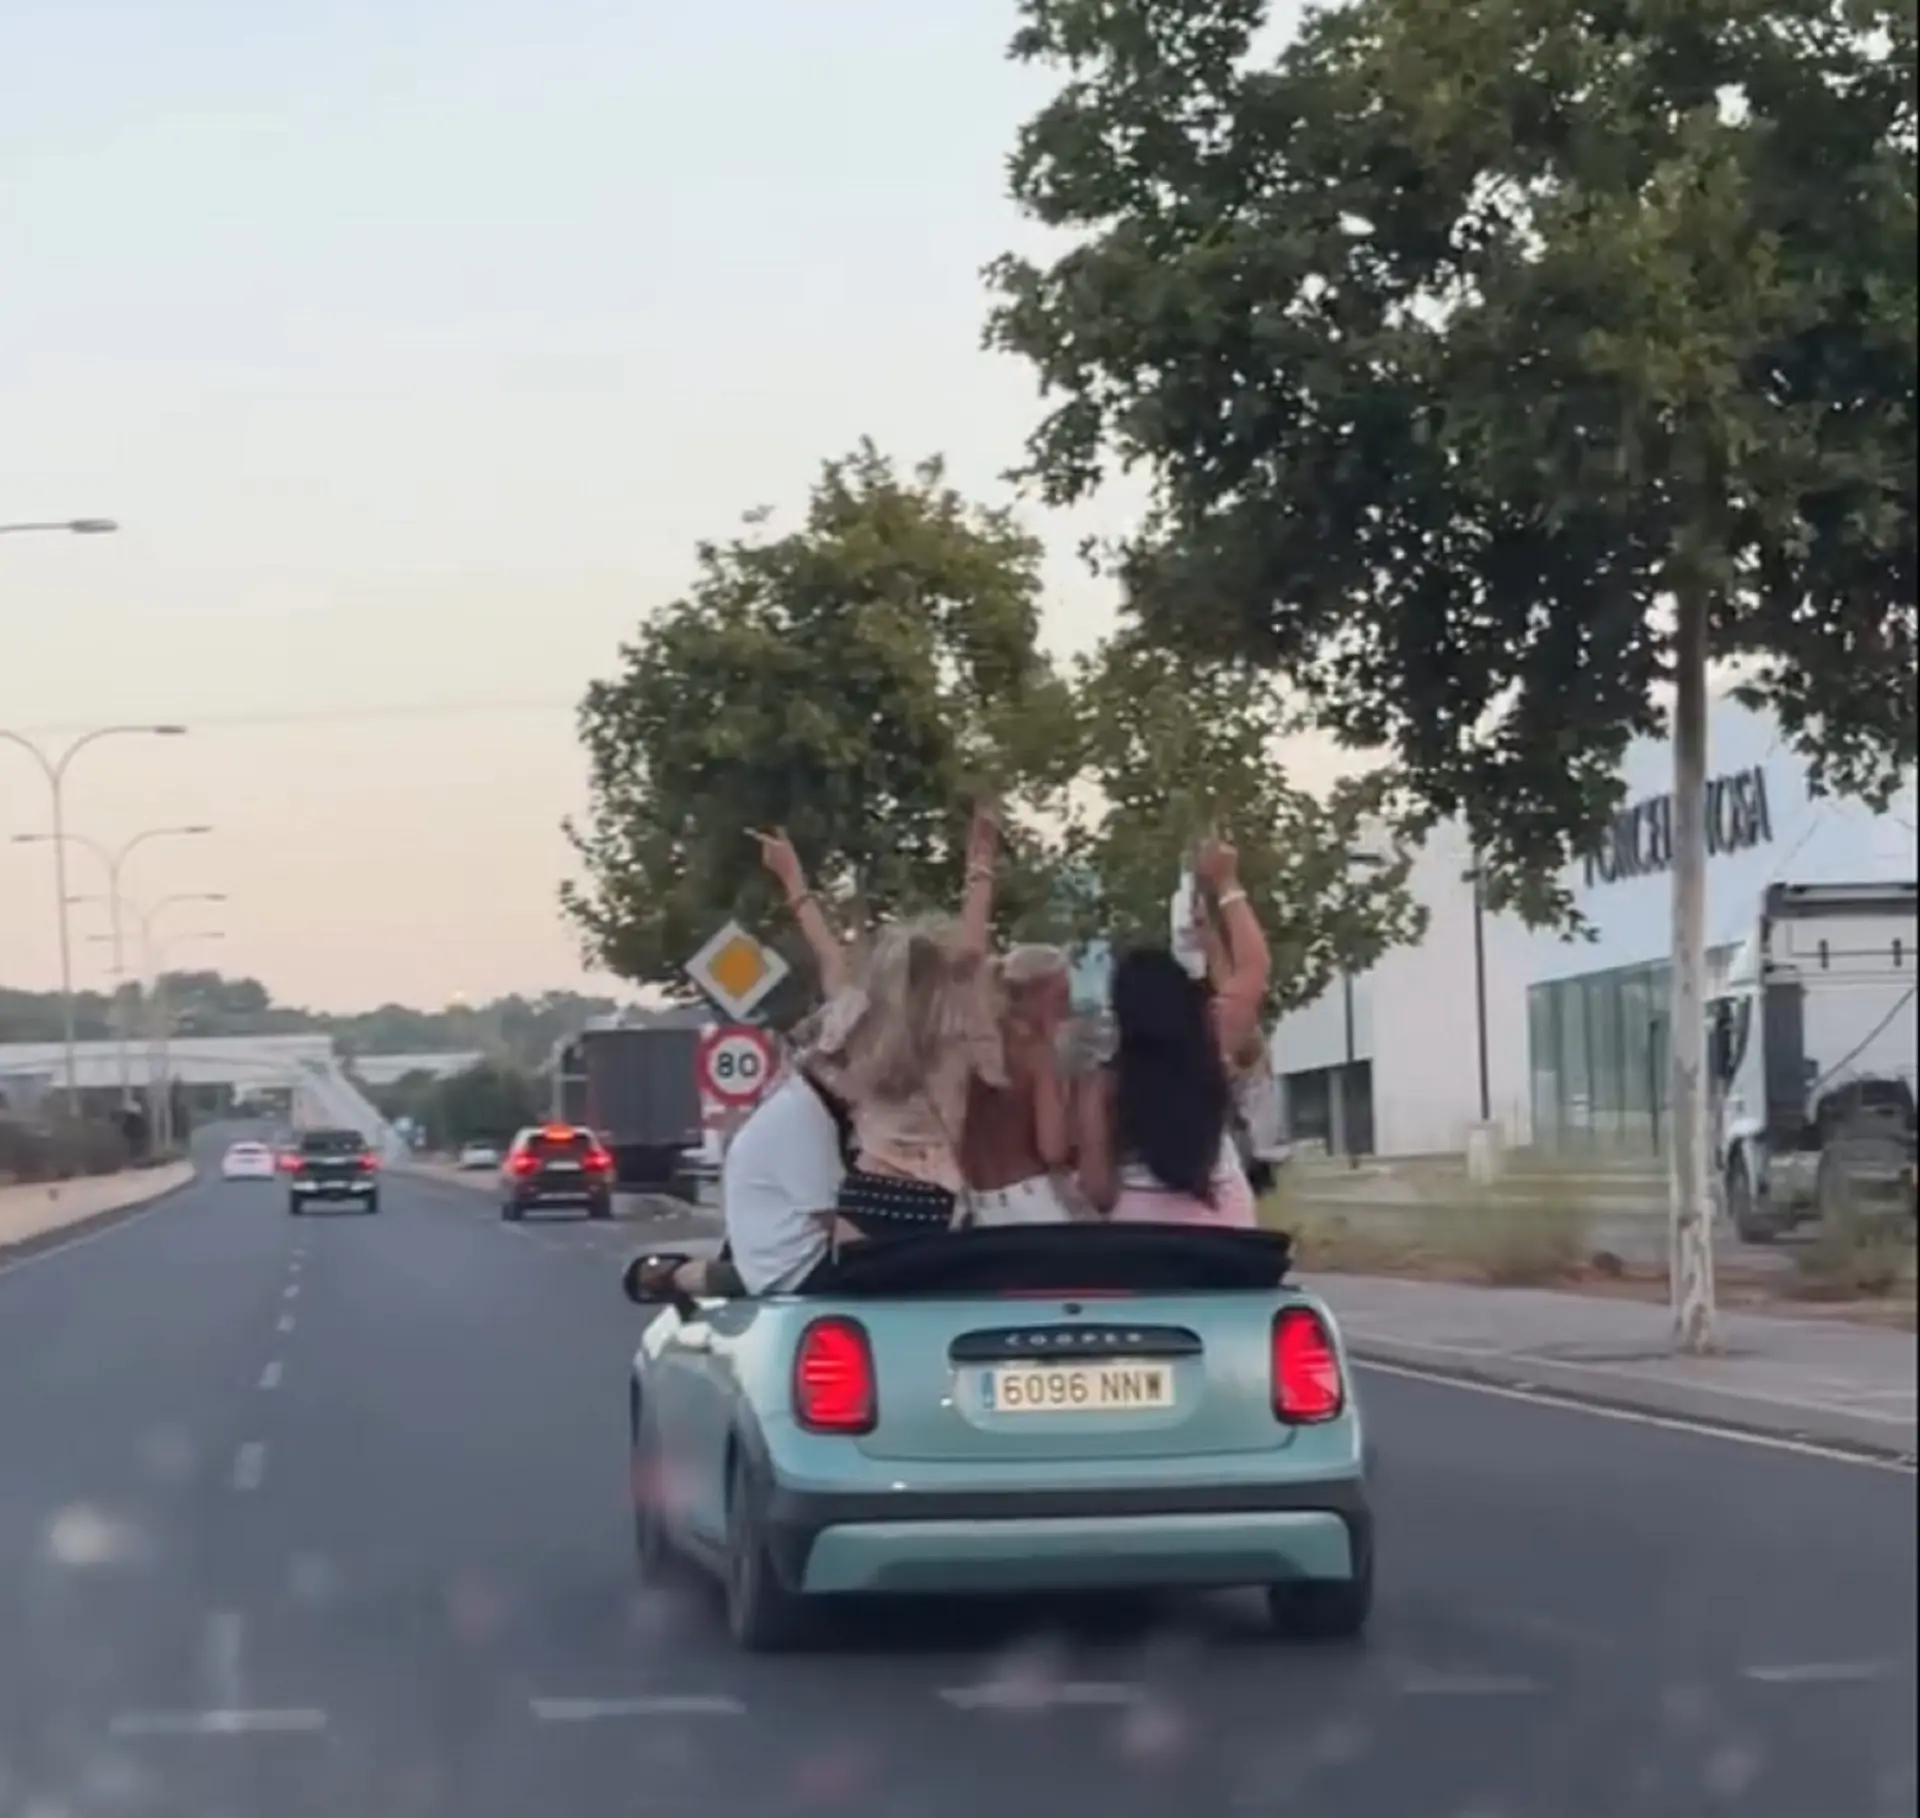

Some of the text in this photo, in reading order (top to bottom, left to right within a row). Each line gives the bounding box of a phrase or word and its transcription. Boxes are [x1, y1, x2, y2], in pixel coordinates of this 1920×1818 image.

[717, 1052, 759, 1079] 80
[1005, 1332, 1143, 1346] COOPER
[1002, 1372, 1089, 1405] 6096
